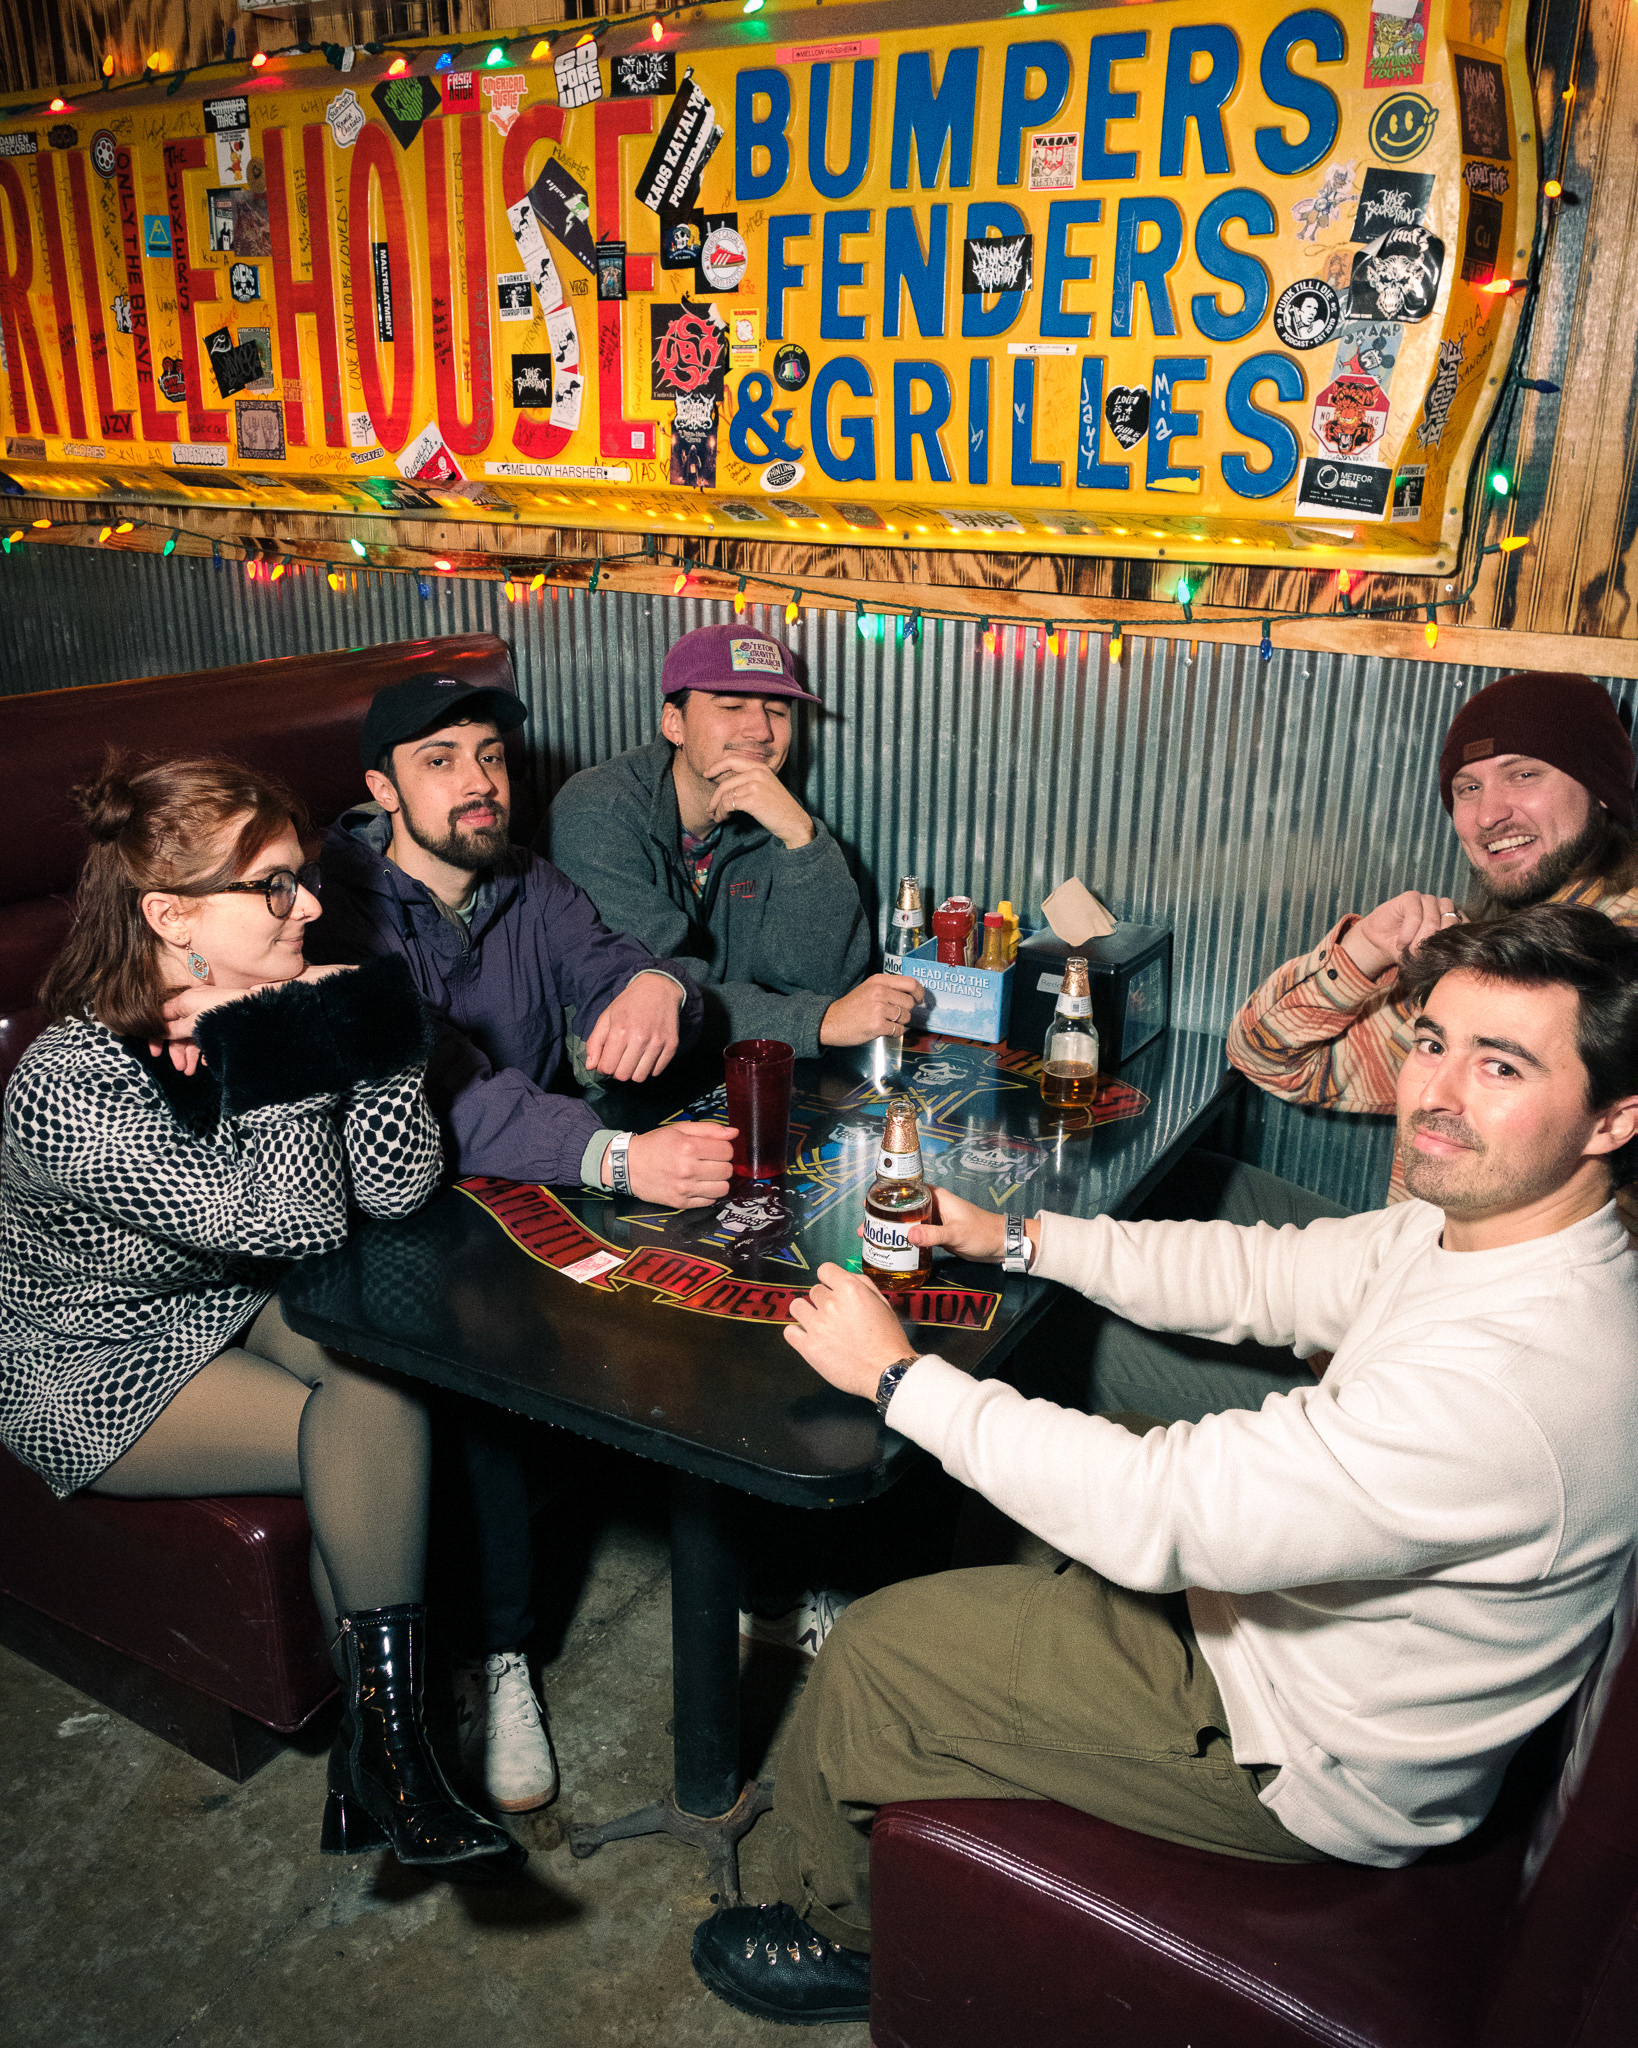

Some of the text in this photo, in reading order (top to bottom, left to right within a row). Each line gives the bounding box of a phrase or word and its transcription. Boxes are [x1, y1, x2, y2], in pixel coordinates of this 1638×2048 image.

[800, 45, 853, 58] MELLOW HARSHER
[1368, 54, 1424, 68] FORTUNATE
[1371, 66, 1414, 80] YOUTH
[483, 76, 527, 94] AMERICAN
[329, 95, 355, 119] SUPPORT
[493, 93, 518, 110] HUSTLE
[736, 9, 1346, 201] BUMPERS
[0, 133, 29, 146] DAMIEN
[0, 143, 37, 156] RECORDS
[116, 152, 136, 226] ONLY
[644, 164, 673, 212] KAOS
[1474, 225, 1491, 249] Cu
[124, 234, 142, 285] THE
[766, 188, 1276, 342] FENDERS
[379, 249, 393, 337] MALTREATMENT
[1277, 288, 1295, 315] PUNK
[1293, 280, 1314, 292] TILL
[1319, 283, 1335, 300] DIE
[129, 293, 154, 383] BRAVE
[1281, 332, 1310, 349] PODCAST
[1343, 323, 1404, 345] SWAMP
[1320, 411, 1331, 421] NO
[511, 464, 603, 479] MELLOW HARSHER
[1340, 471, 1373, 484] METEOR
[1339, 479, 1359, 489] GEM
[749, 650, 776, 660] GRAVITY
[750, 641, 774, 653] TETON
[746, 657, 781, 670] RESEARCH
[912, 966, 990, 989] HEAD FOR THE
[919, 978, 983, 998] MOUNTAINS
[613, 1151, 627, 1179] VIP
[864, 1217, 906, 1247] Modelo
[626, 1253, 711, 1295] FOR
